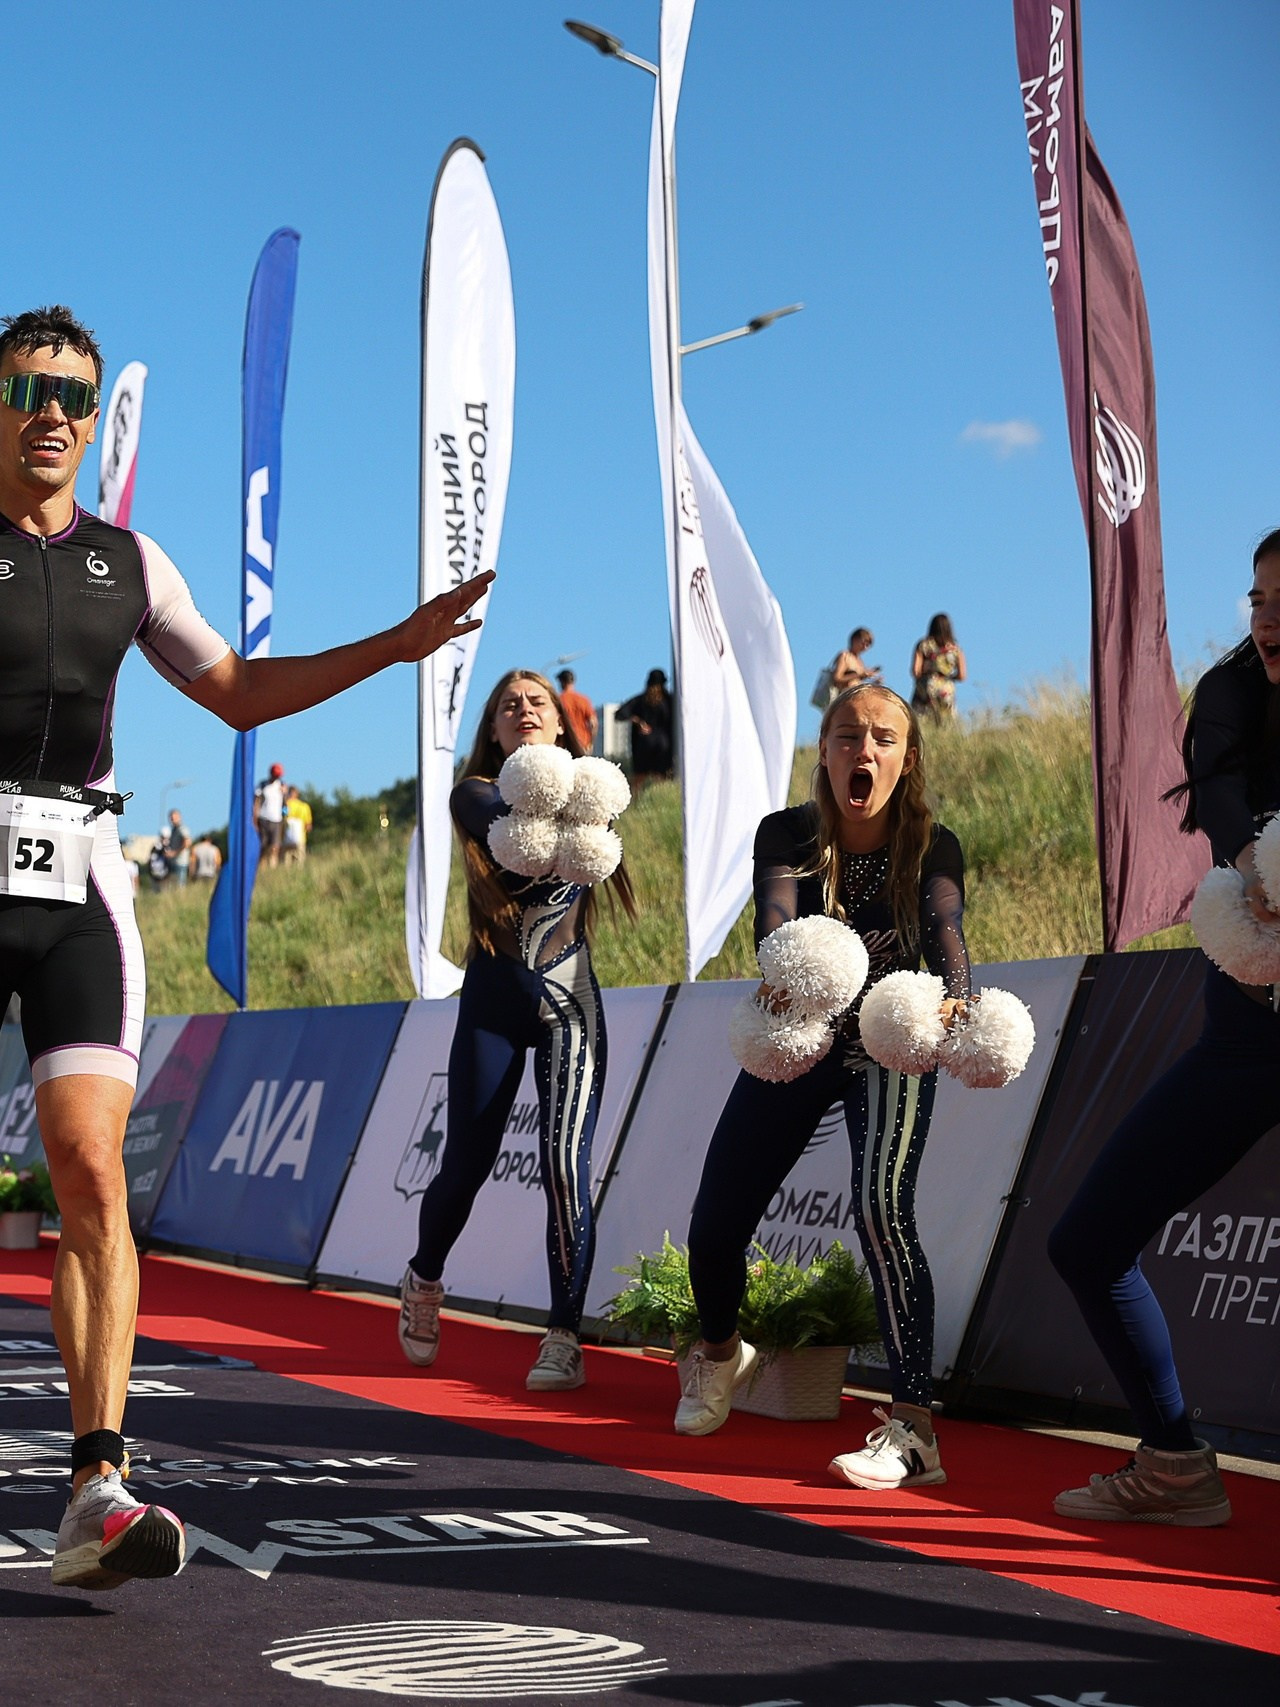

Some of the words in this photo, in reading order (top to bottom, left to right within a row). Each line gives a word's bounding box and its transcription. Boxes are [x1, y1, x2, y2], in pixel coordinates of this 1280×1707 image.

[433, 432, 468, 586] ИЖНИЙ
[463, 401, 489, 577] ВГОРОД
[14, 836, 55, 873] 52
[208, 1080, 325, 1180] AVA
[265, 1511, 630, 1546] STAR
